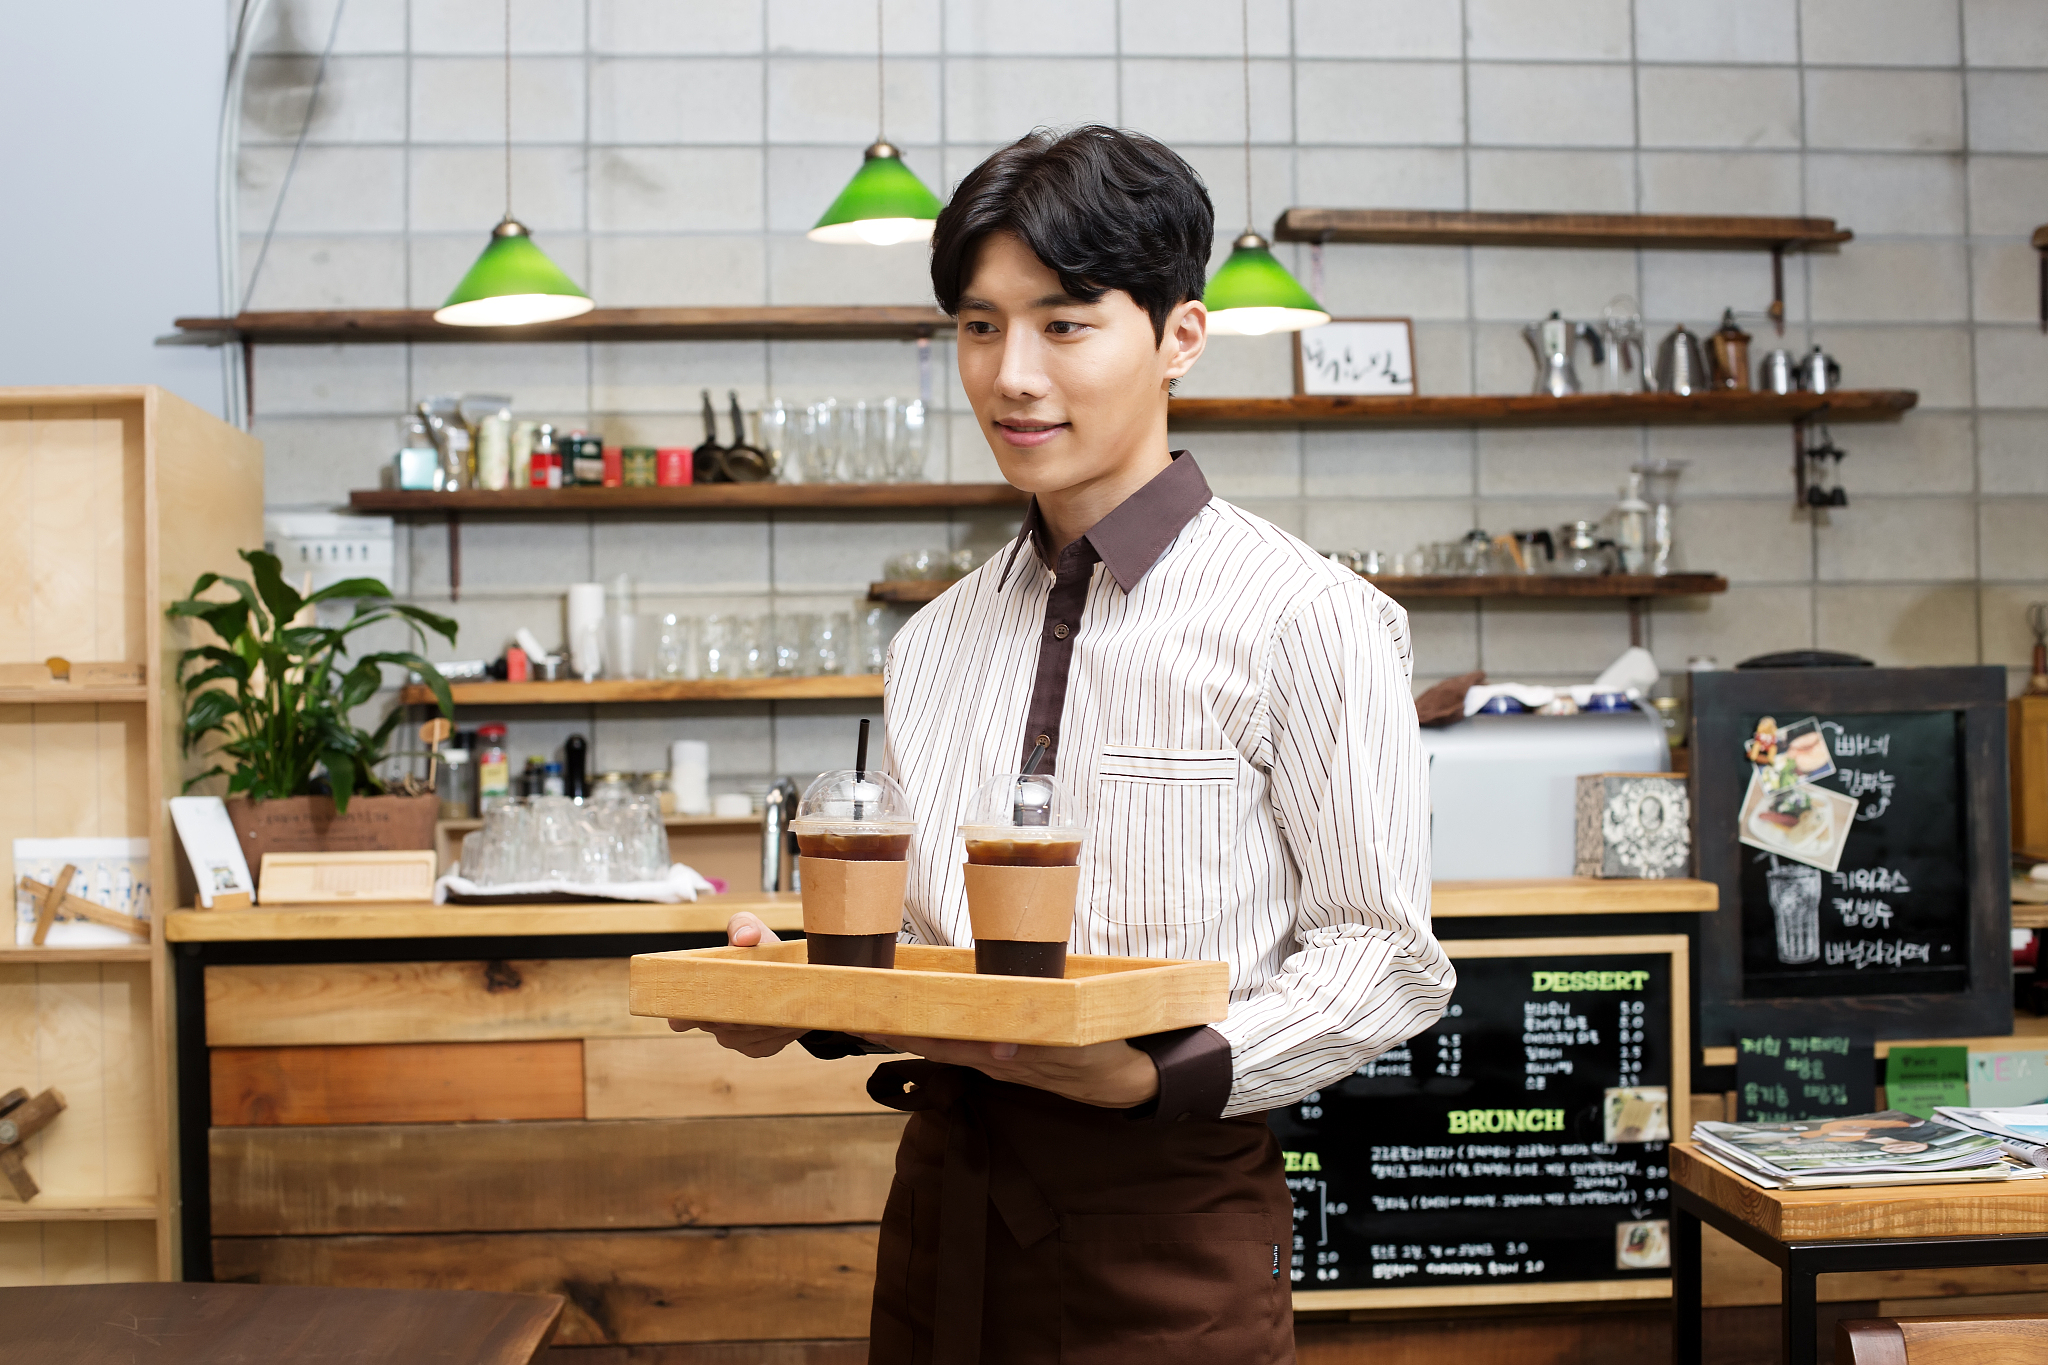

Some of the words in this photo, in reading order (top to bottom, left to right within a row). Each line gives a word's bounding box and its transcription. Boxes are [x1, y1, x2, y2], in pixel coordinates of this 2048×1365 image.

[1834, 733, 1890, 757] 빠네
[1831, 866, 1911, 893] 키위쥬스
[1831, 897, 1894, 929] 컵빙수
[1824, 938, 1930, 970] 바닐라라떼
[1532, 970, 1650, 992] DESSERT
[1437, 1047, 1463, 1062] 4.5
[1435, 1062, 1462, 1077] 4.5
[1448, 1108, 1565, 1134] BRUNCH
[1283, 1150, 1322, 1172] EA
